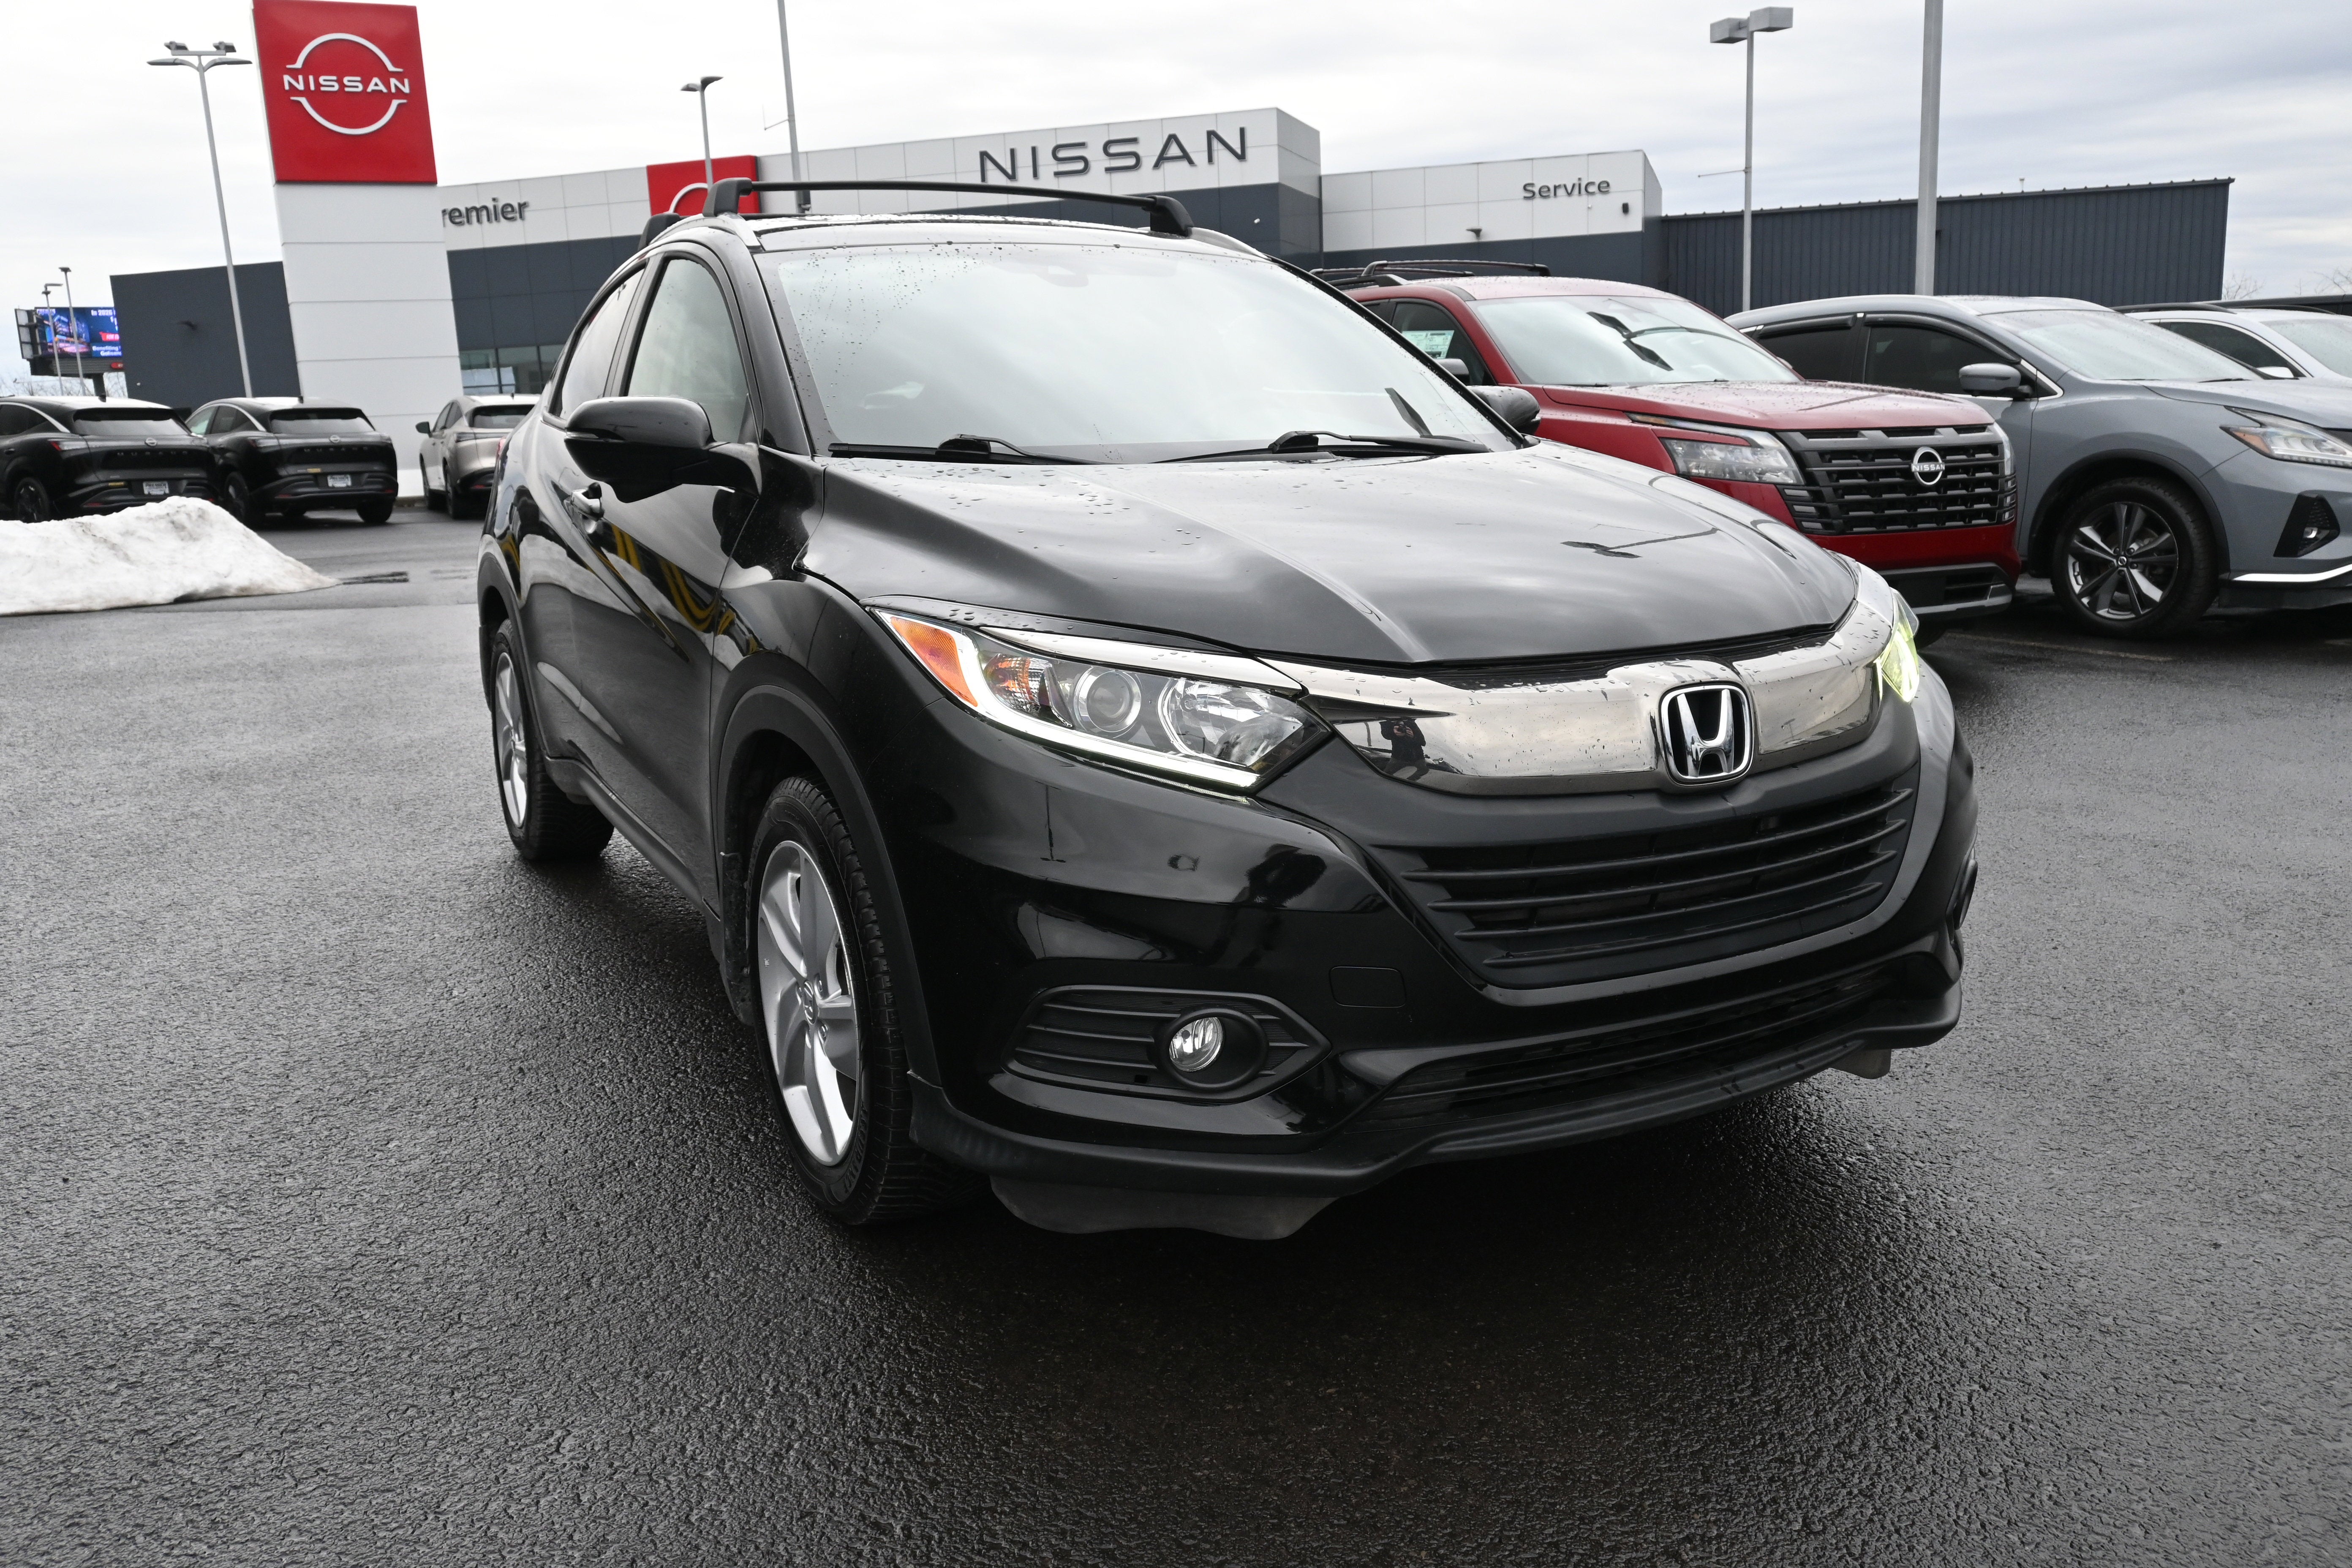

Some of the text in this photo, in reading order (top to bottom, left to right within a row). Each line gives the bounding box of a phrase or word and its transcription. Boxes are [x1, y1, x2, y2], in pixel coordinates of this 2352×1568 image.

[283, 74, 410, 94] NISSAN
[979, 127, 1247, 183] NISSAN
[1523, 177, 1611, 199] Service
